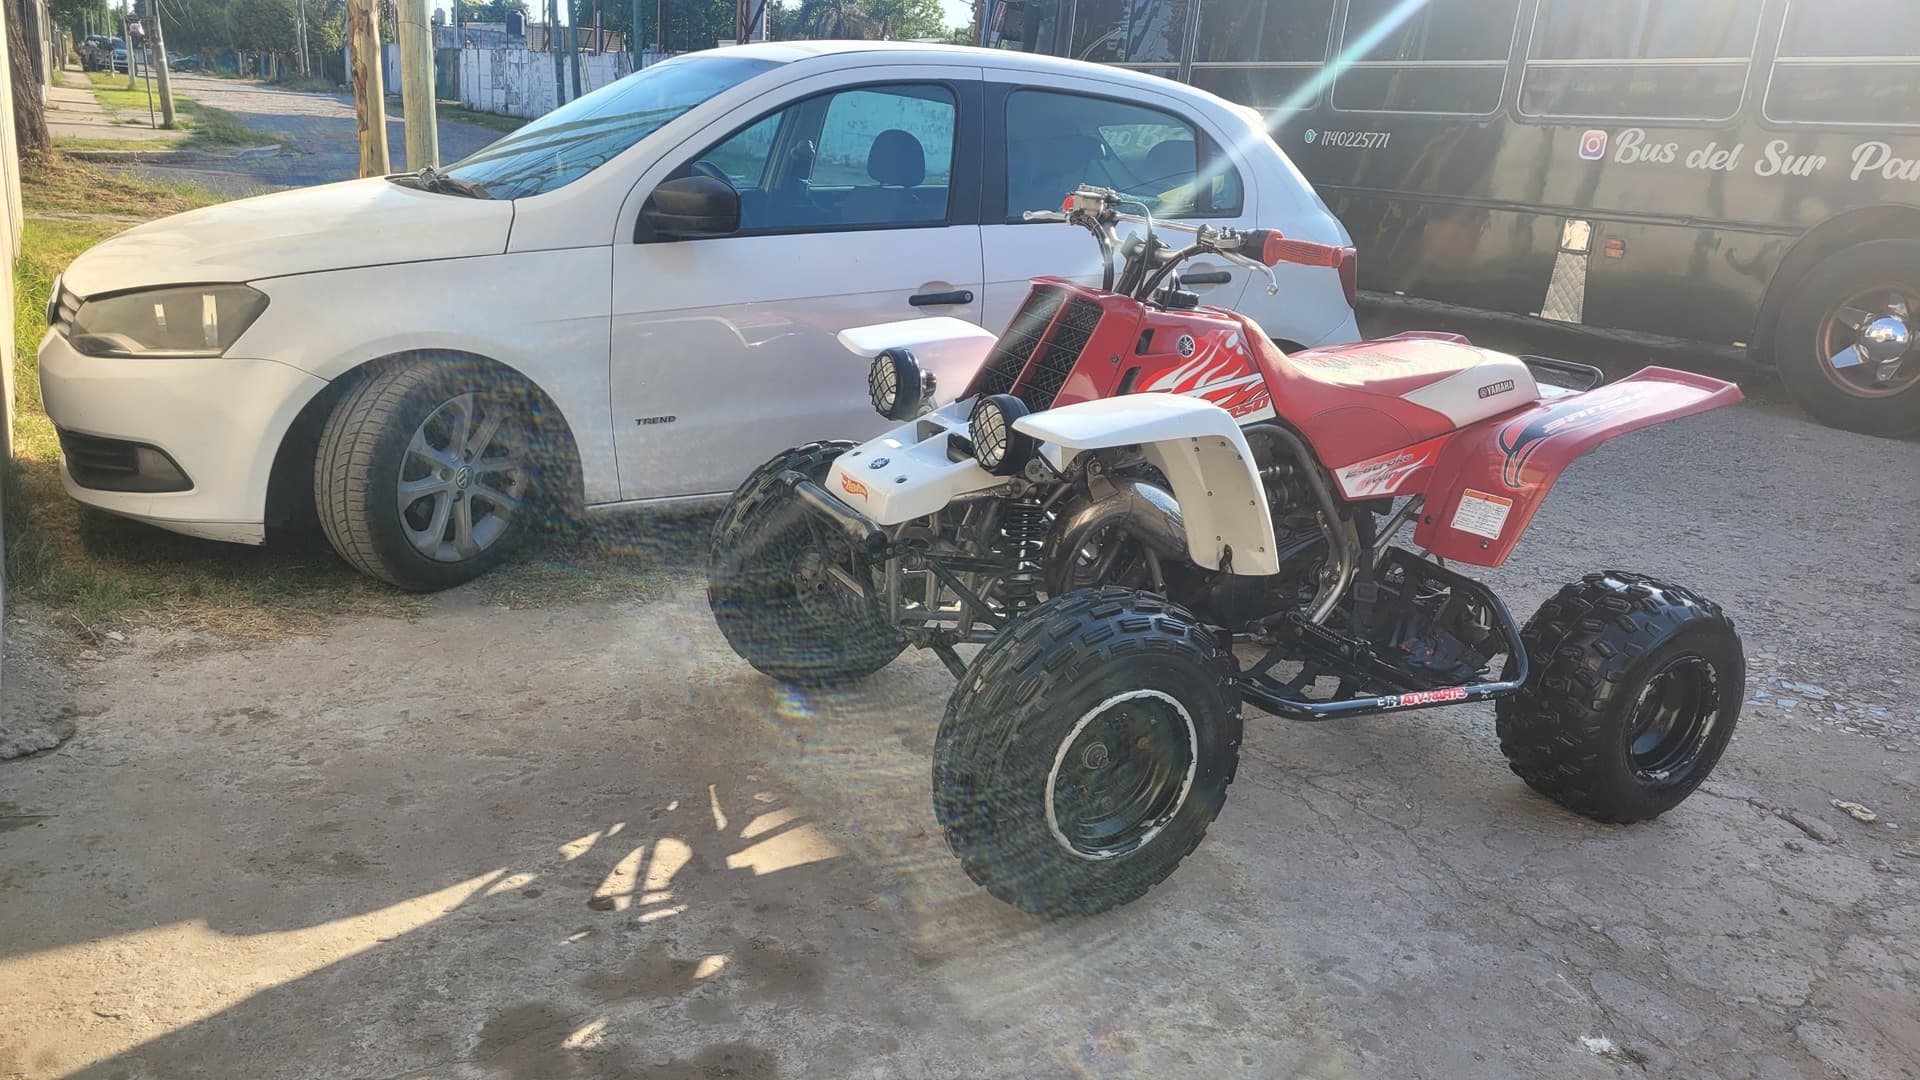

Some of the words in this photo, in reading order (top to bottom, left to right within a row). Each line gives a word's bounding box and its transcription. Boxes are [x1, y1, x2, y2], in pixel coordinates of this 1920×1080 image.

[1321, 131, 1391, 149] 1140225771
[1613, 127, 1679, 164] Bus
[1686, 142, 1744, 171] del
[1754, 140, 1826, 177] Sur
[1487, 380, 1514, 396] YAMAHA
[635, 415, 677, 426] TREND
